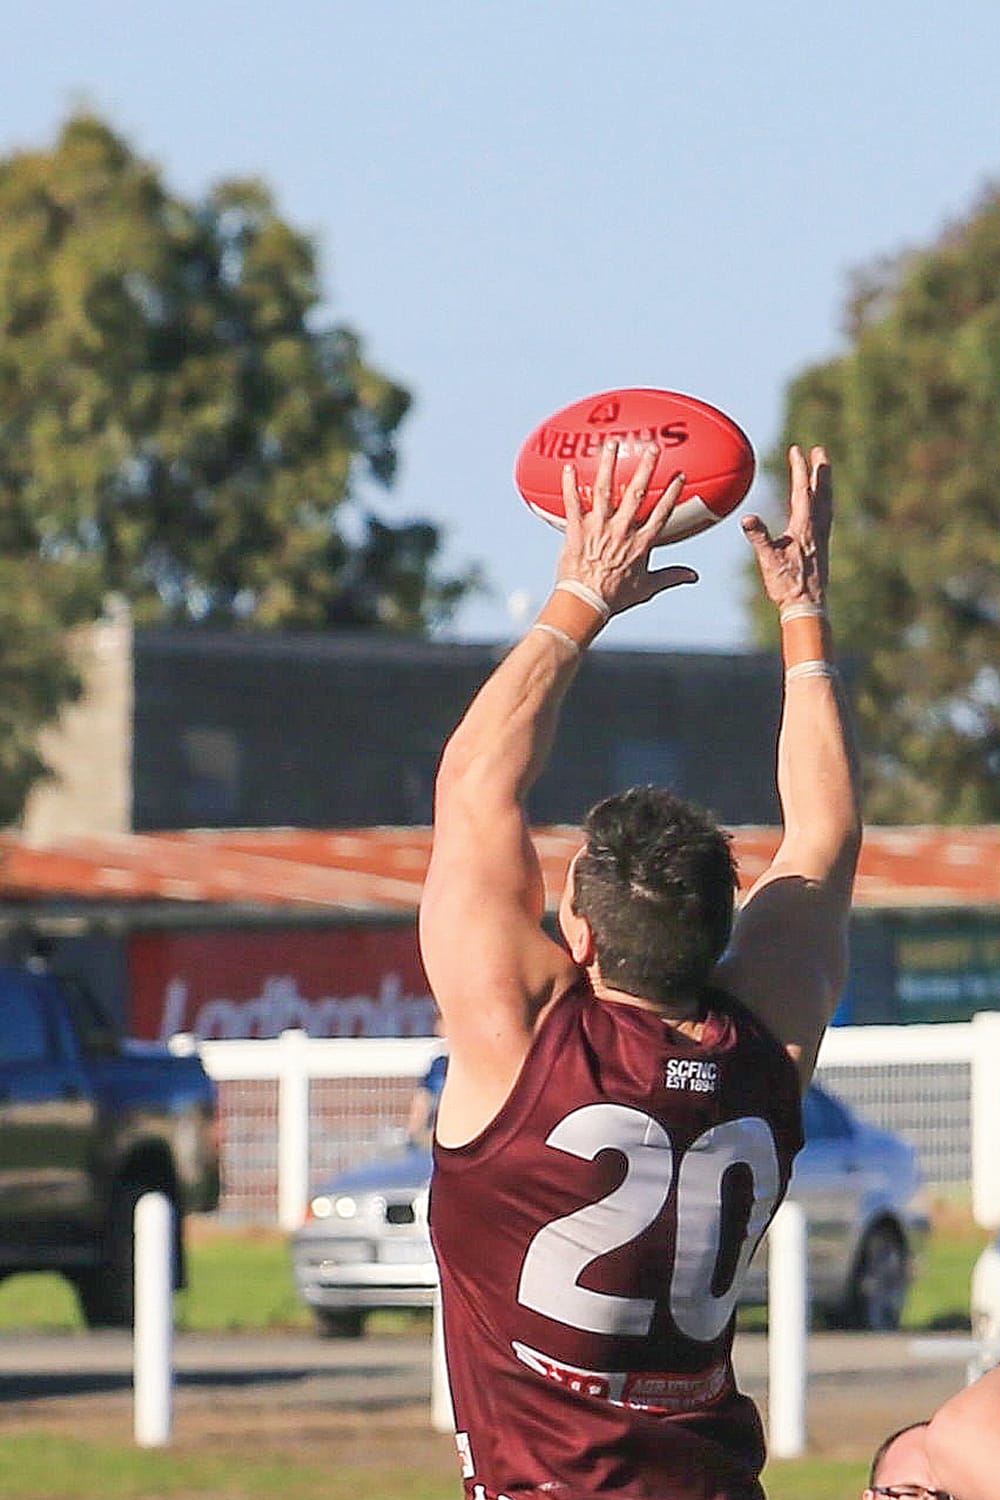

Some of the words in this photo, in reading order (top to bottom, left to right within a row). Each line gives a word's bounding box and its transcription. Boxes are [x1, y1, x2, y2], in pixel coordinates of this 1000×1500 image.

[666, 1058, 717, 1080] SCFNC
[666, 1076, 687, 1089] EST
[517, 1103, 780, 1342] 20
